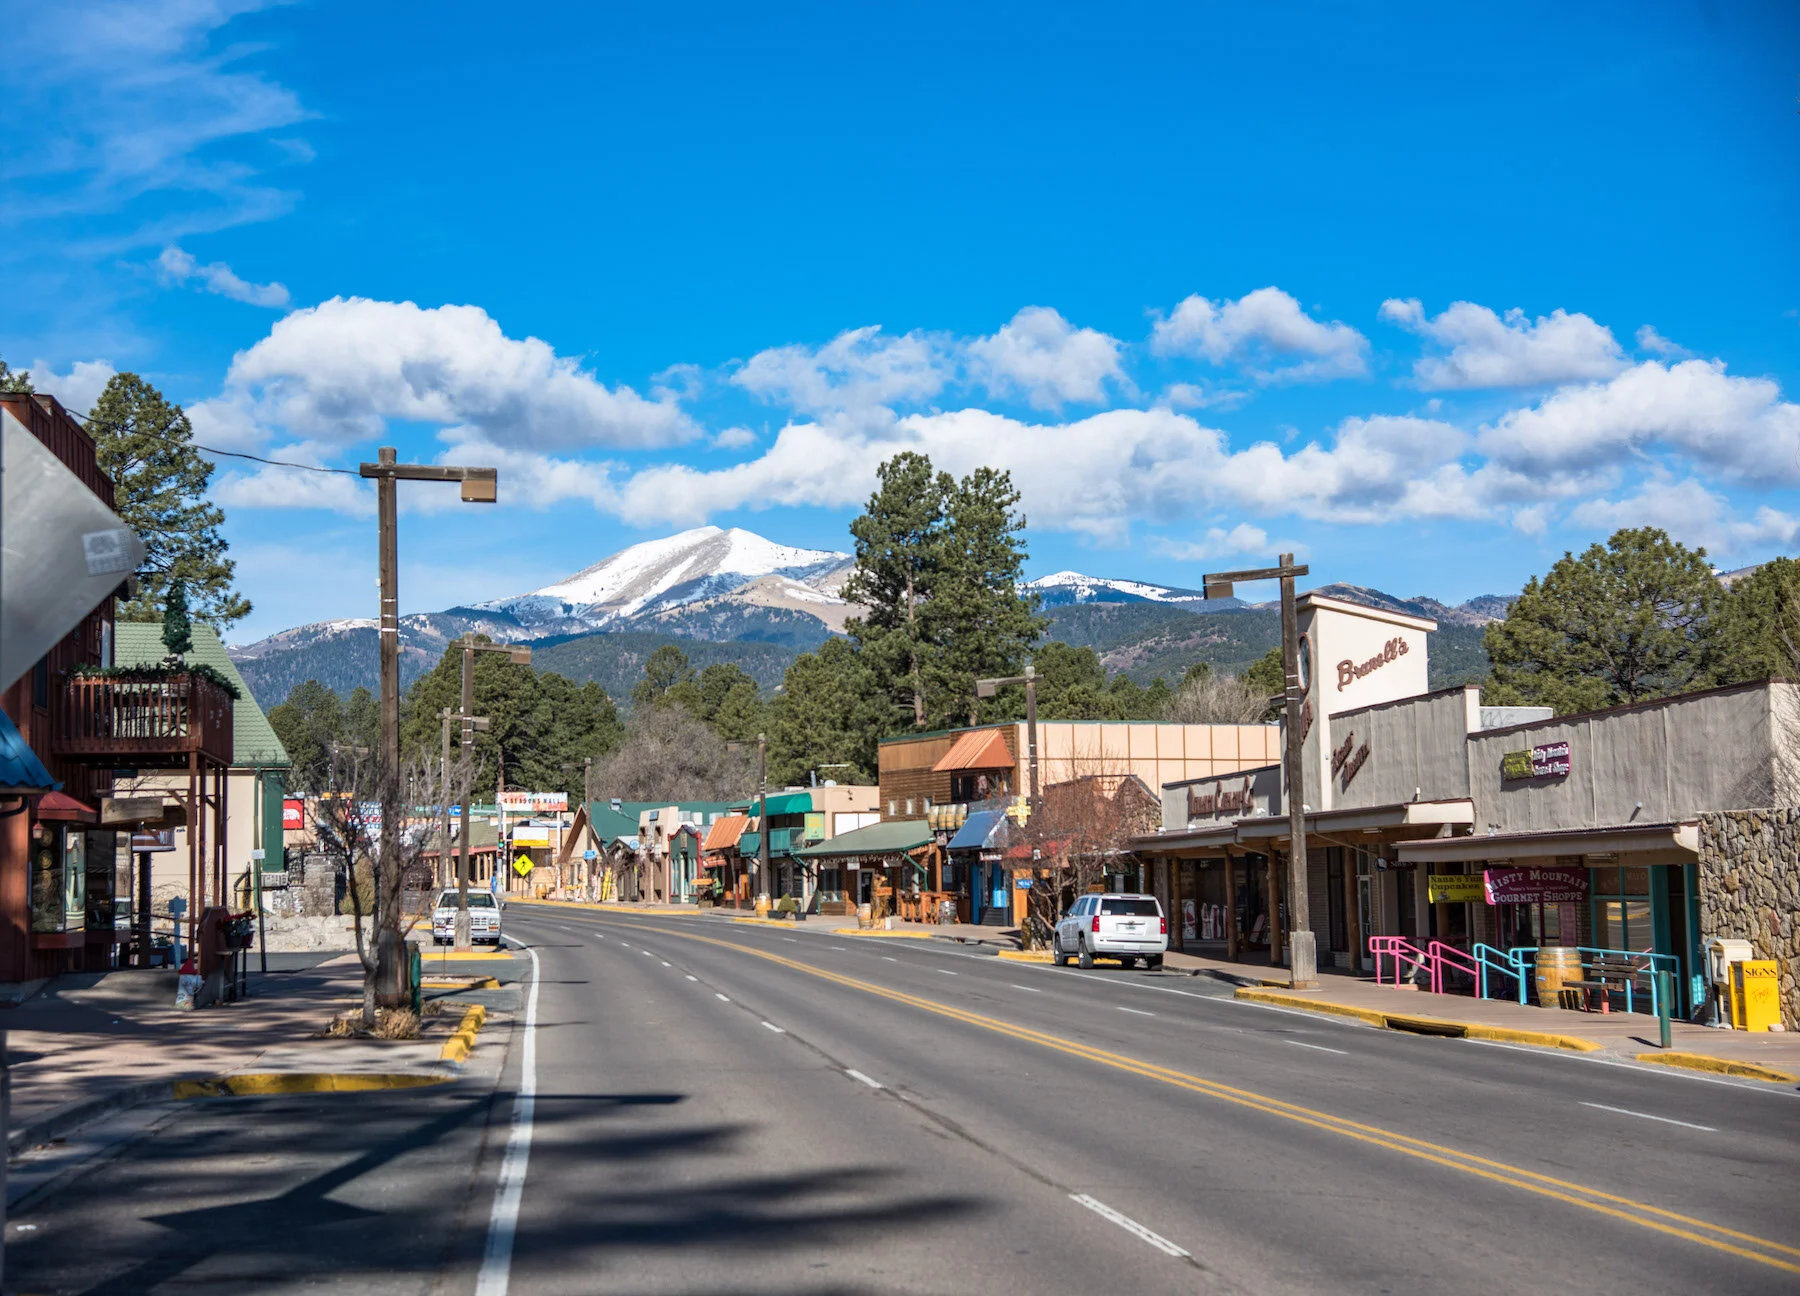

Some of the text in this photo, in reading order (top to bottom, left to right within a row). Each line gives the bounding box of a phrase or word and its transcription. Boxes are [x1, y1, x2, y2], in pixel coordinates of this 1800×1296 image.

[1336, 636, 1409, 692] Brunell's
[1484, 872, 1523, 893] MISTY
[1529, 869, 1589, 890] MOUNTAIN
[1490, 891, 1540, 902] GOURMET
[1543, 890, 1583, 901] SHOPPE
[1745, 967, 1777, 977] SIGNS
